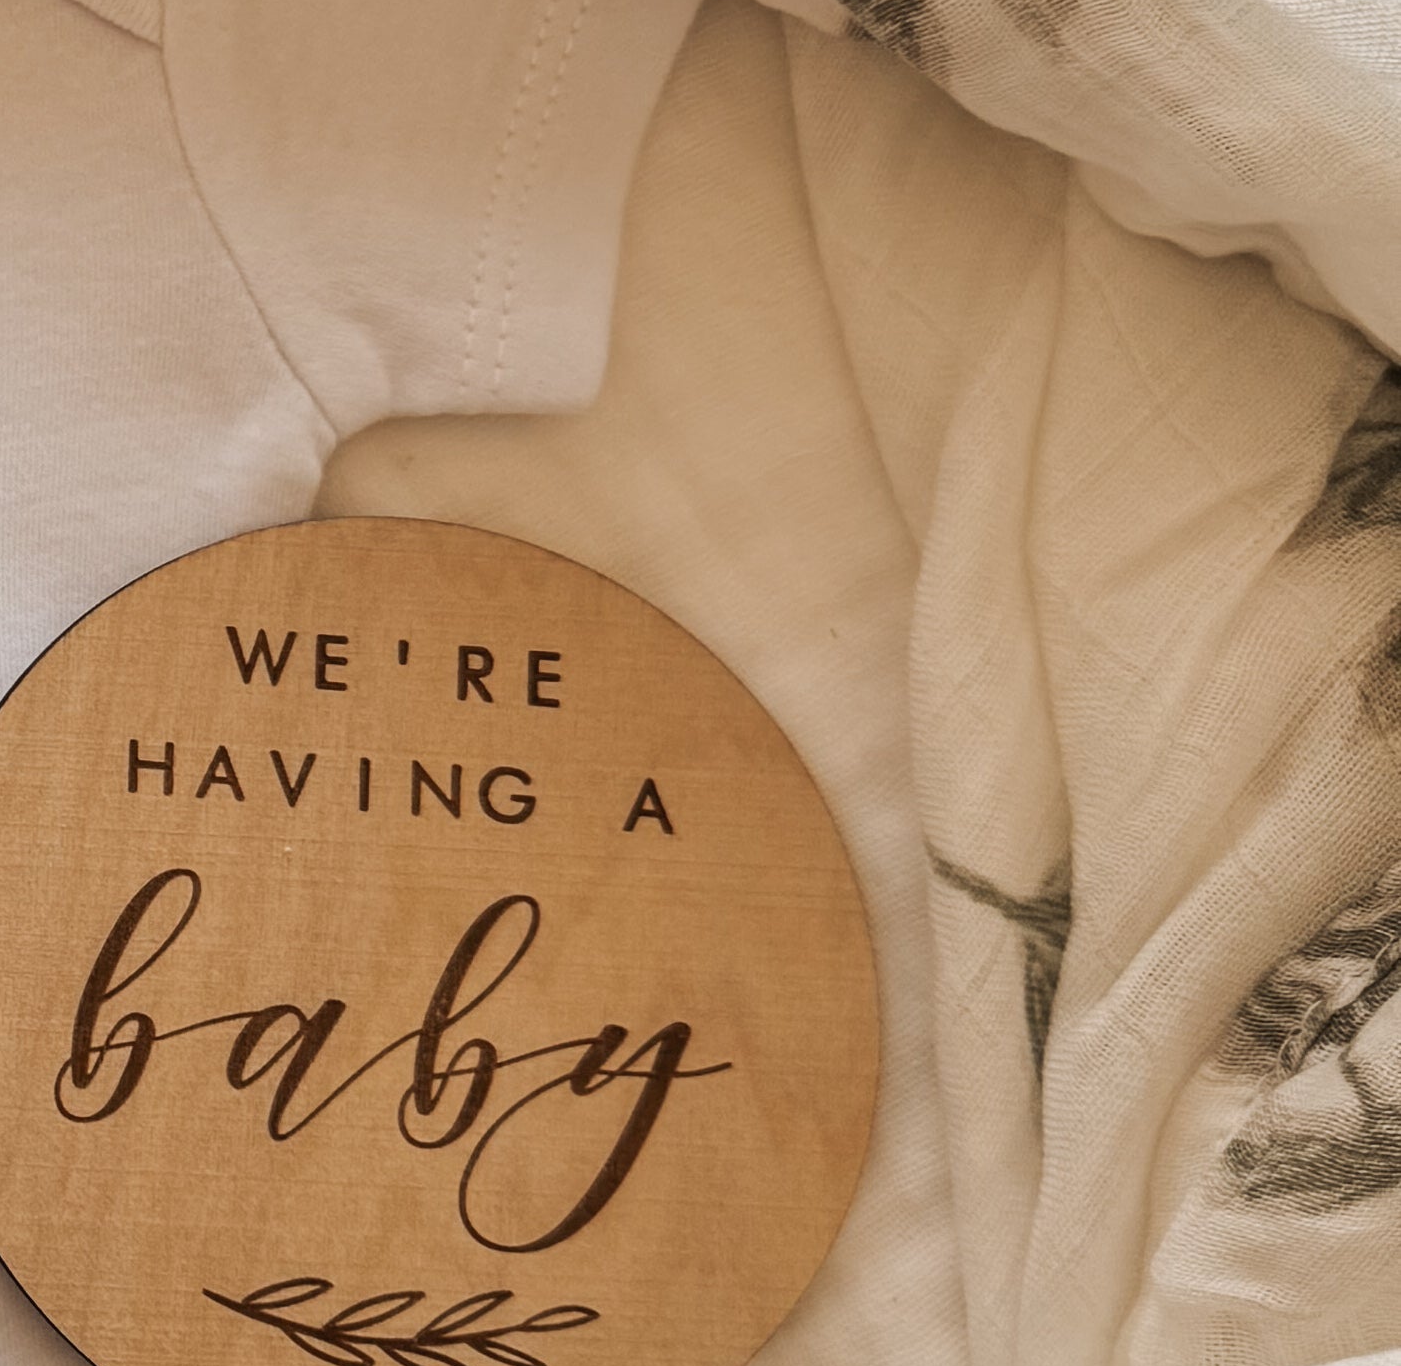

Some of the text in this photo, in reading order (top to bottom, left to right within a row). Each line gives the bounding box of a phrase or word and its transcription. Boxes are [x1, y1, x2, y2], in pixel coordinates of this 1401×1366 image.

[225, 625, 562, 709] WE'RE
[127, 738, 675, 836] HAVING A
[53, 868, 733, 1254] baby
